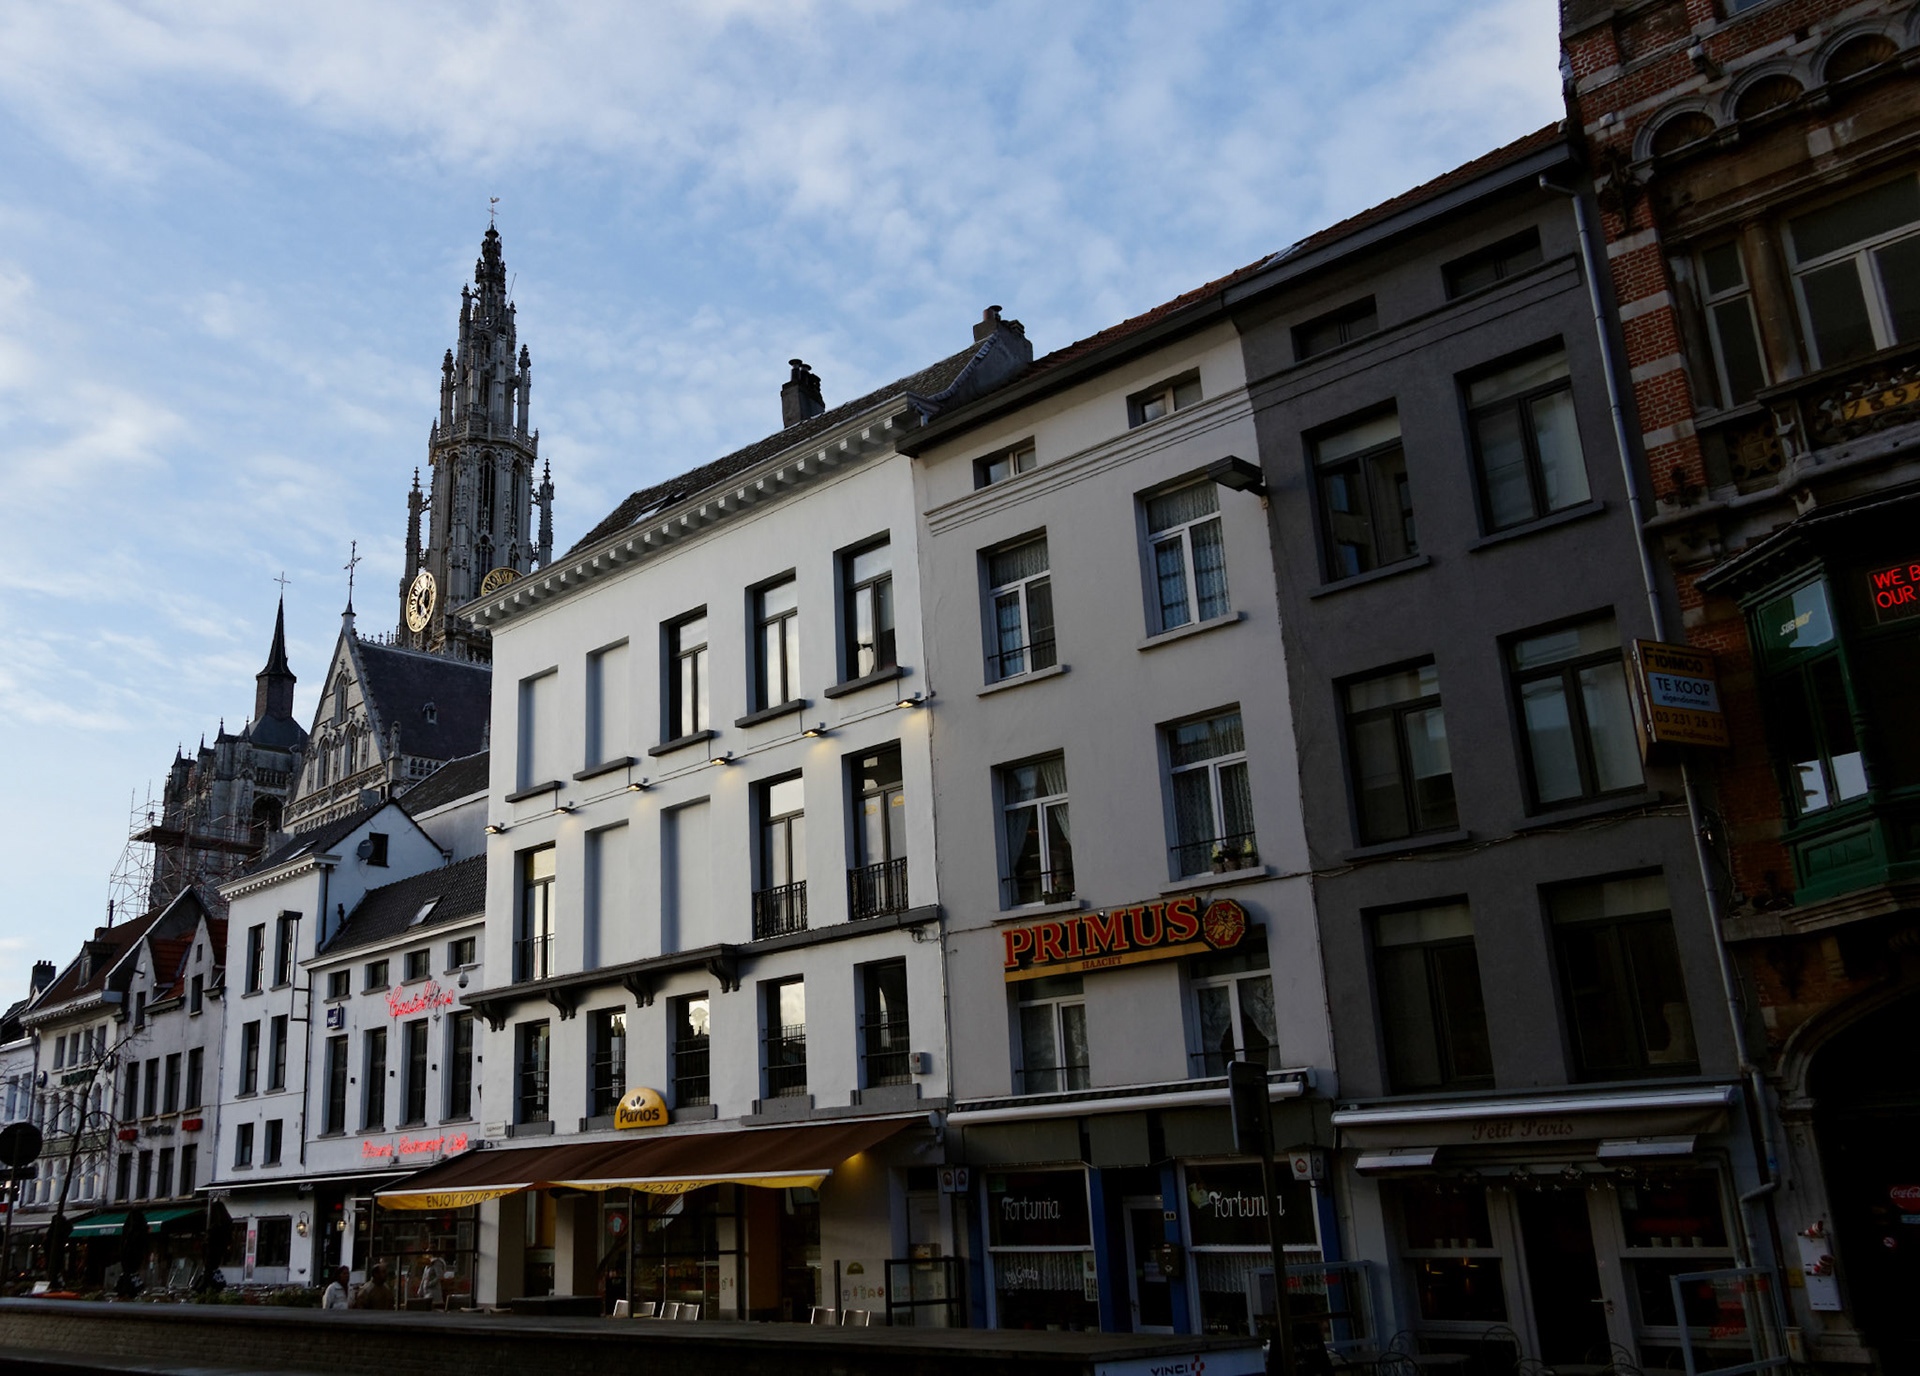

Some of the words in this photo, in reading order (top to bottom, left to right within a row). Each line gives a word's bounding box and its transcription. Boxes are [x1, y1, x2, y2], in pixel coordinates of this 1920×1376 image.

[1873, 568, 1905, 589] WE
[1908, 565, 1920, 581] B
[1877, 585, 1918, 608] OUR
[1643, 647, 1703, 673] FIDIMCO
[1656, 677, 1671, 691] TE
[1675, 679, 1710, 696] KOOP
[1656, 711, 1669, 723] 03
[1672, 713, 1691, 726] 231
[1002, 897, 1200, 967] PRIMUS
[1082, 956, 1122, 970] HAACHT
[620, 1108, 659, 1123] Panos
[1472, 1119, 1514, 1140] Petit
[1521, 1119, 1573, 1138] Paris
[426, 1193, 456, 1207] ENJOY
[1151, 1363, 1188, 1376] VINCI
